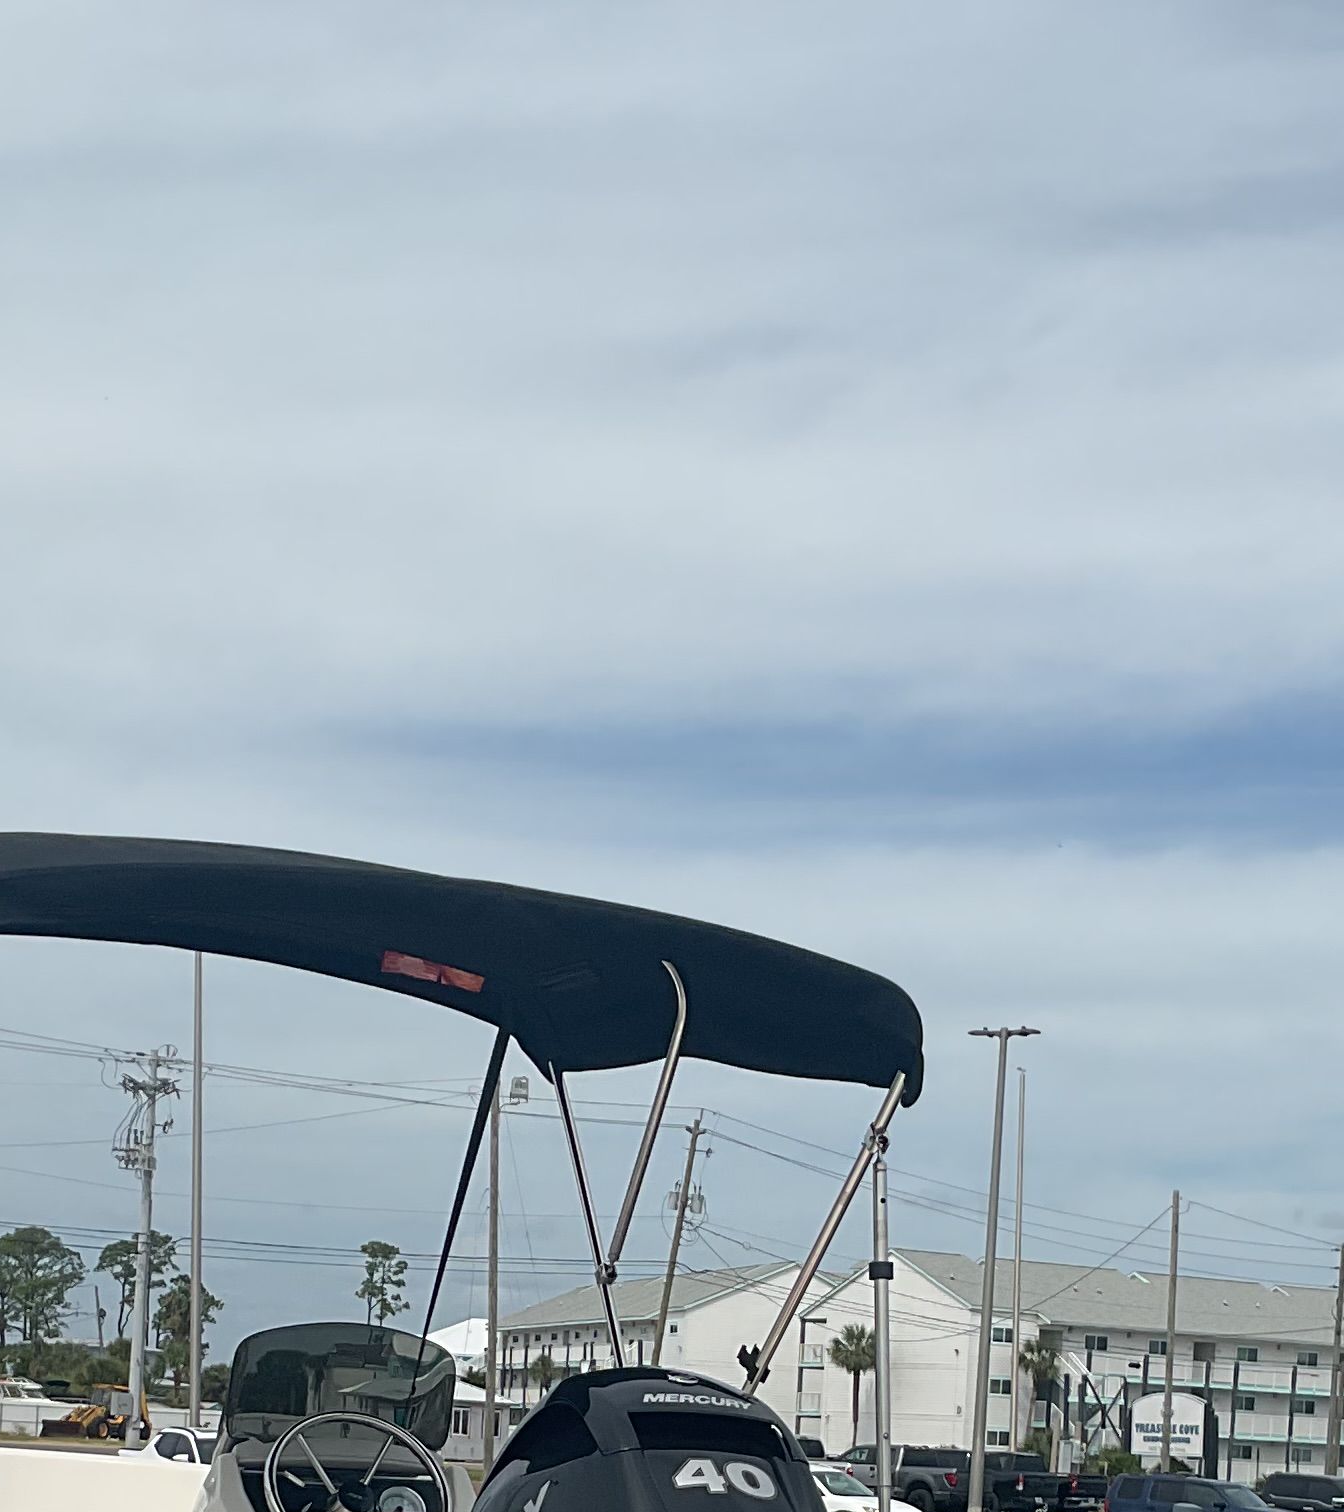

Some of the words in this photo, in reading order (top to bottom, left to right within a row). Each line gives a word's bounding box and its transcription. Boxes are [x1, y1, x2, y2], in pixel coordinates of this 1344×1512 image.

[642, 1393, 752, 1410] MERCURY
[1135, 1423, 1177, 1435] TREASE
[1179, 1424, 1200, 1435] COVE
[672, 1458, 777, 1500] 40
